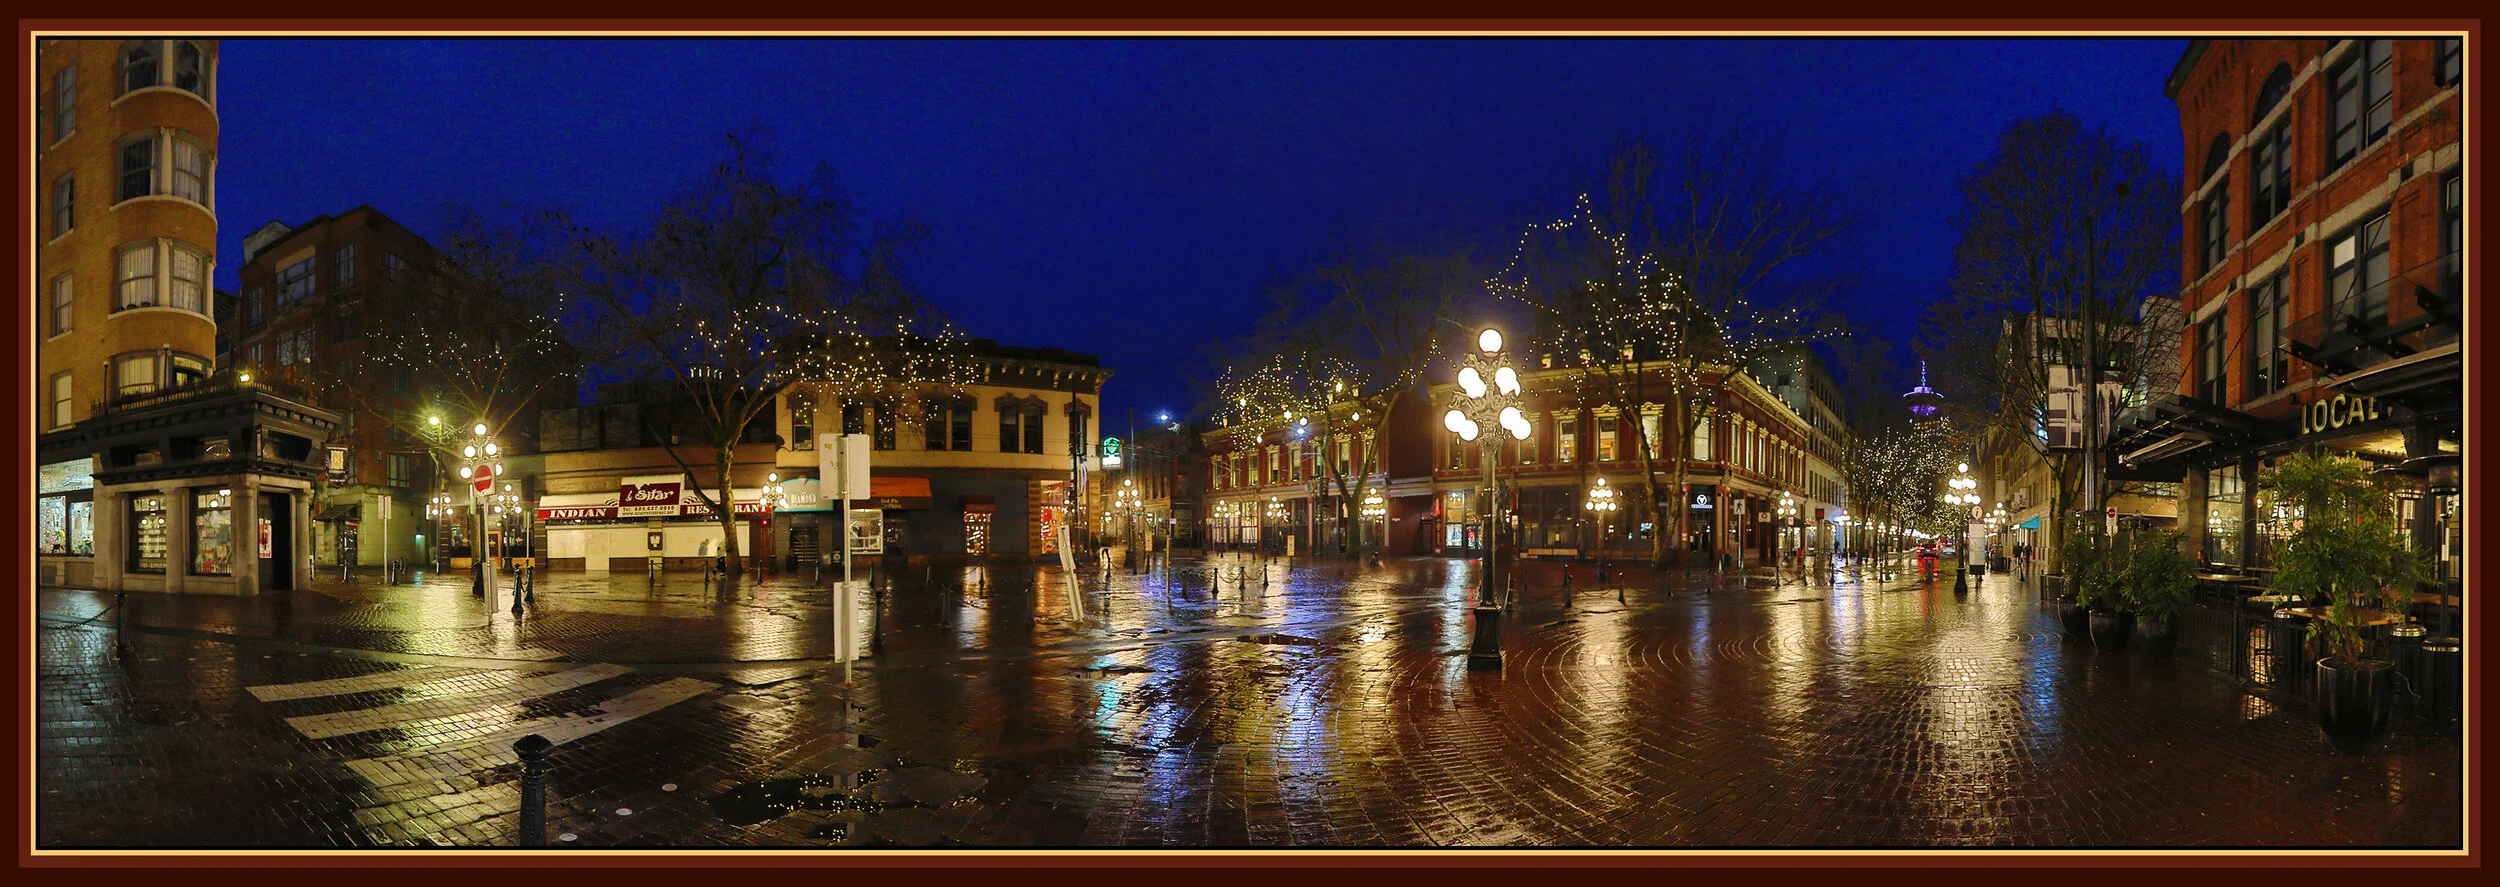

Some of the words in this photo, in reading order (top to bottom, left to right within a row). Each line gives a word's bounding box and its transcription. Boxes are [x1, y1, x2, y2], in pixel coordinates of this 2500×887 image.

[2302, 394, 2378, 435] LOCAL
[790, 494, 817, 504] DIAMOND
[549, 508, 607, 518] INDIAN
[687, 502, 767, 515] RESRANT
